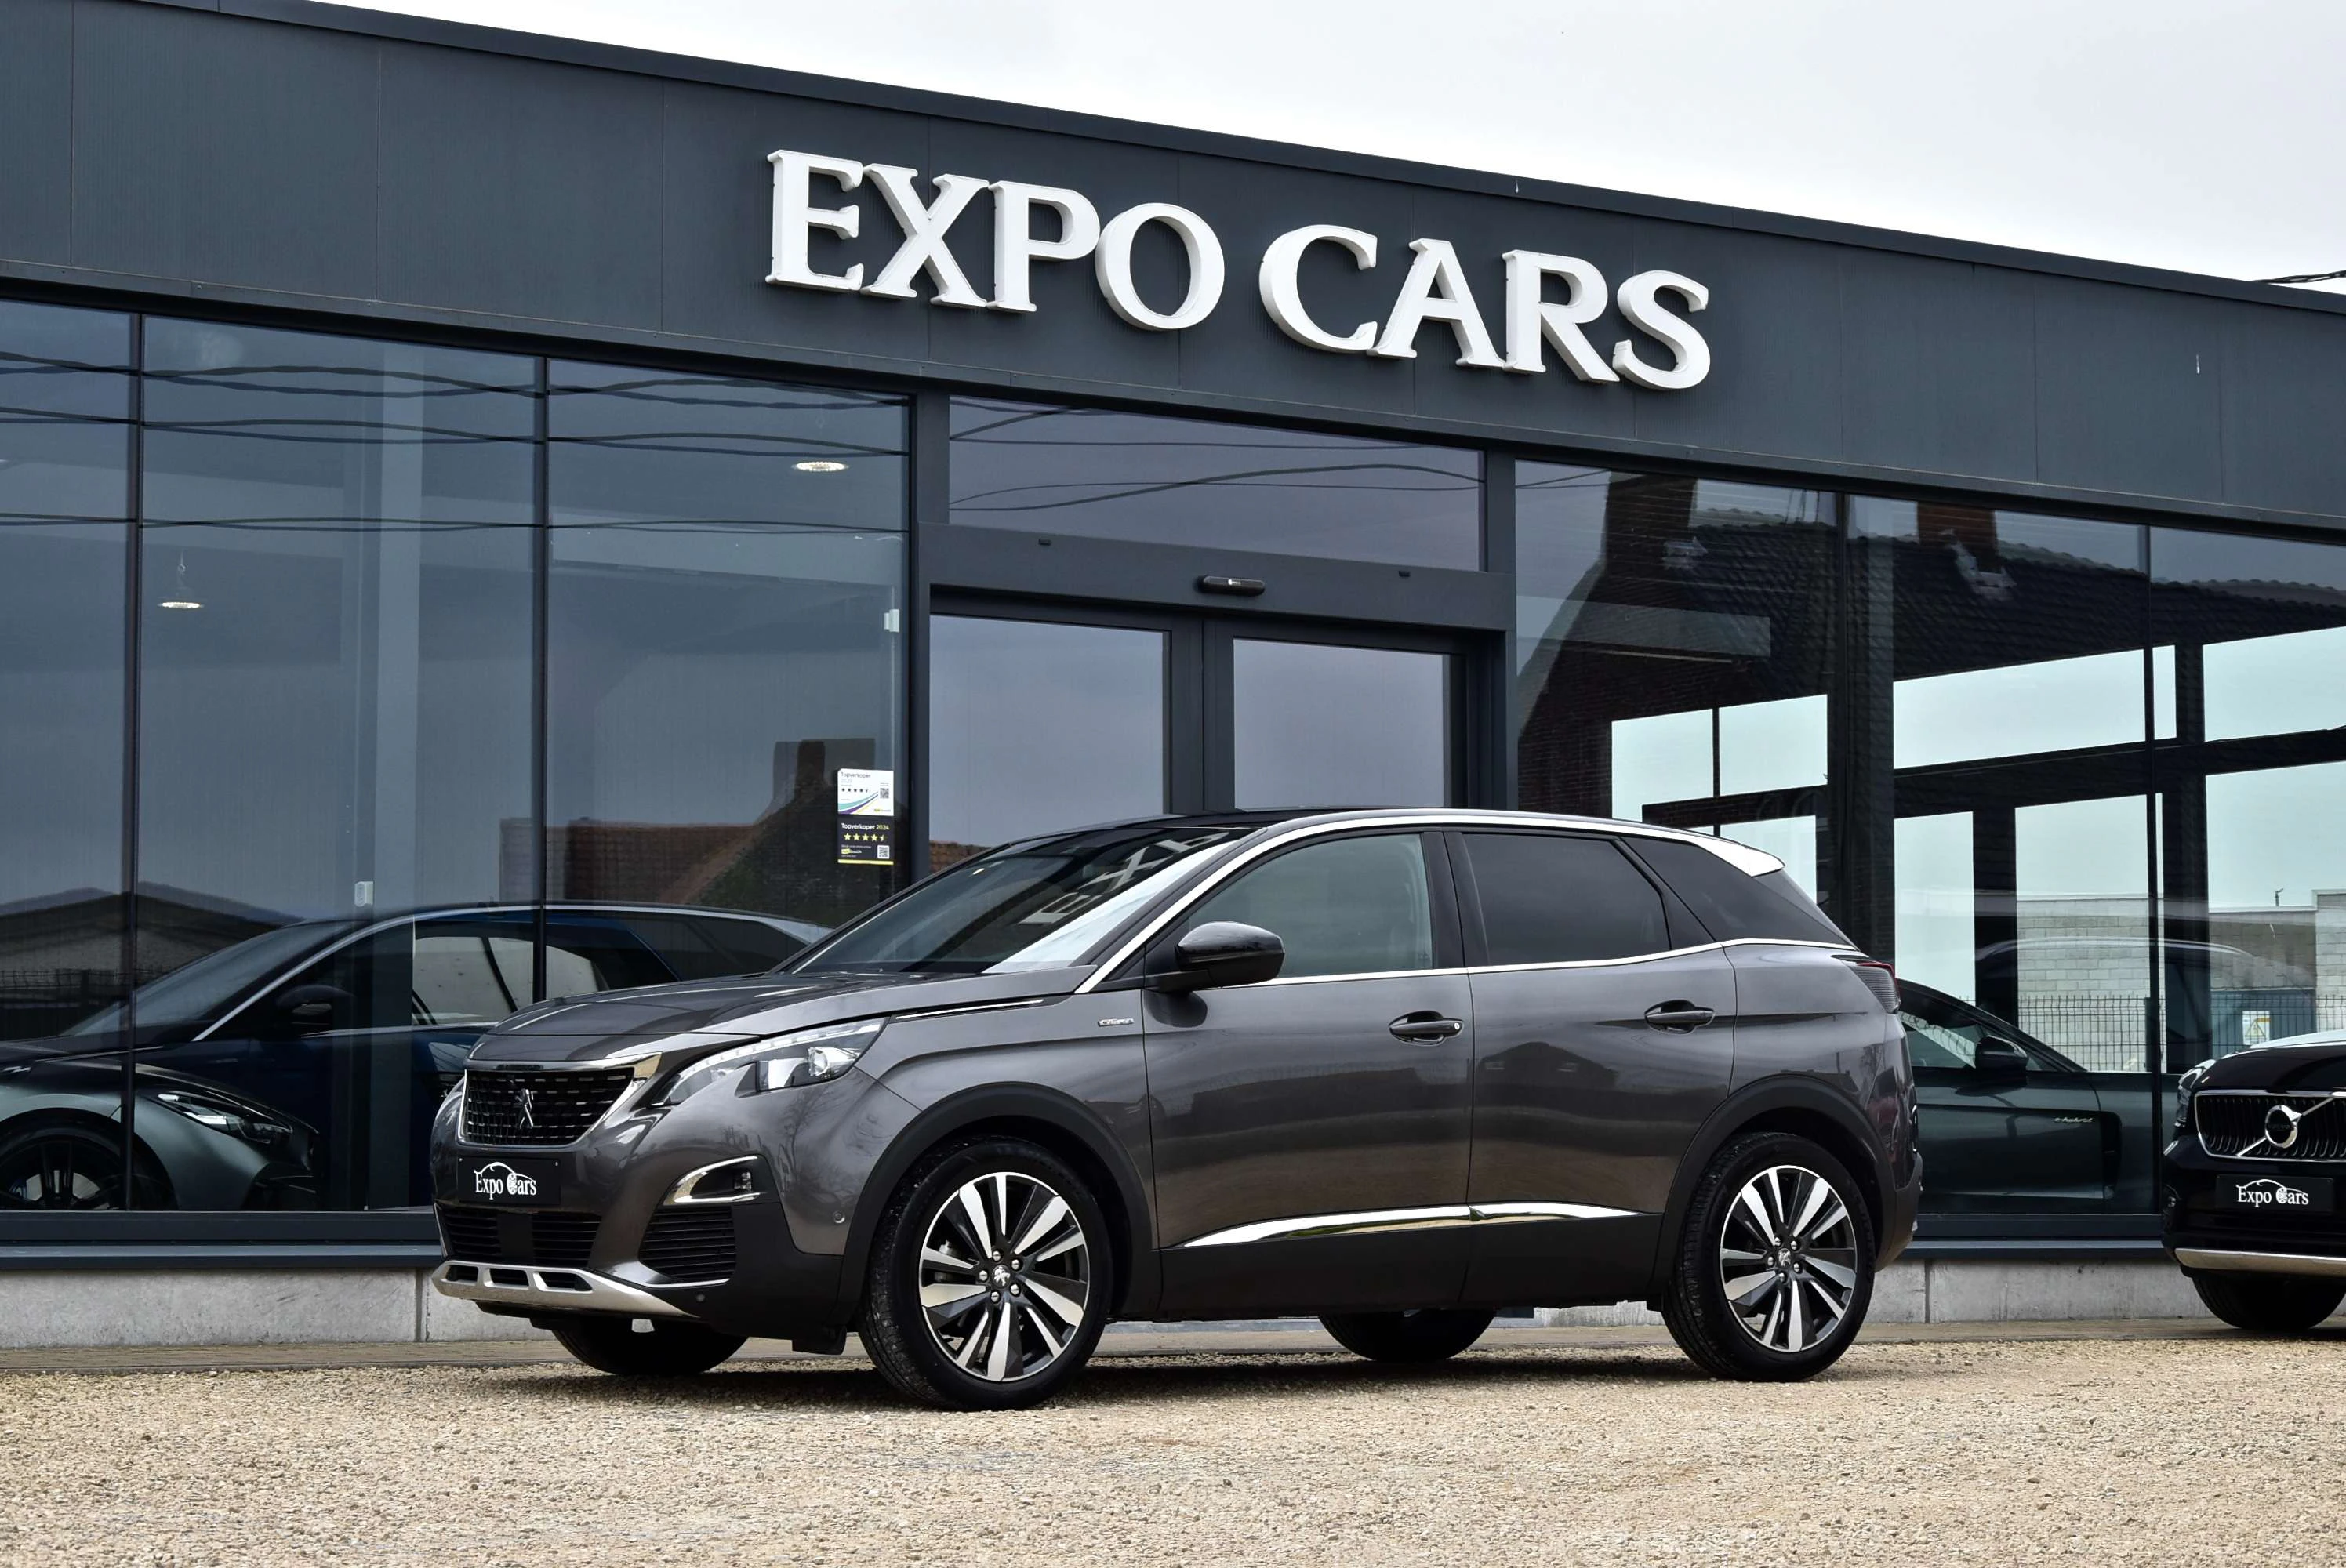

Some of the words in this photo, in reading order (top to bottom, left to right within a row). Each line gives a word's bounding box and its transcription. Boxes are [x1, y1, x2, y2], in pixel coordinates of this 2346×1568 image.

[766, 149, 1225, 332] EXPO
[1258, 224, 1711, 391] CARS
[474, 1171, 503, 1200] Expo
[507, 1173, 537, 1196] Cars
[2237, 1185, 2272, 1207] Expo
[2275, 1187, 2309, 1205] Cars
